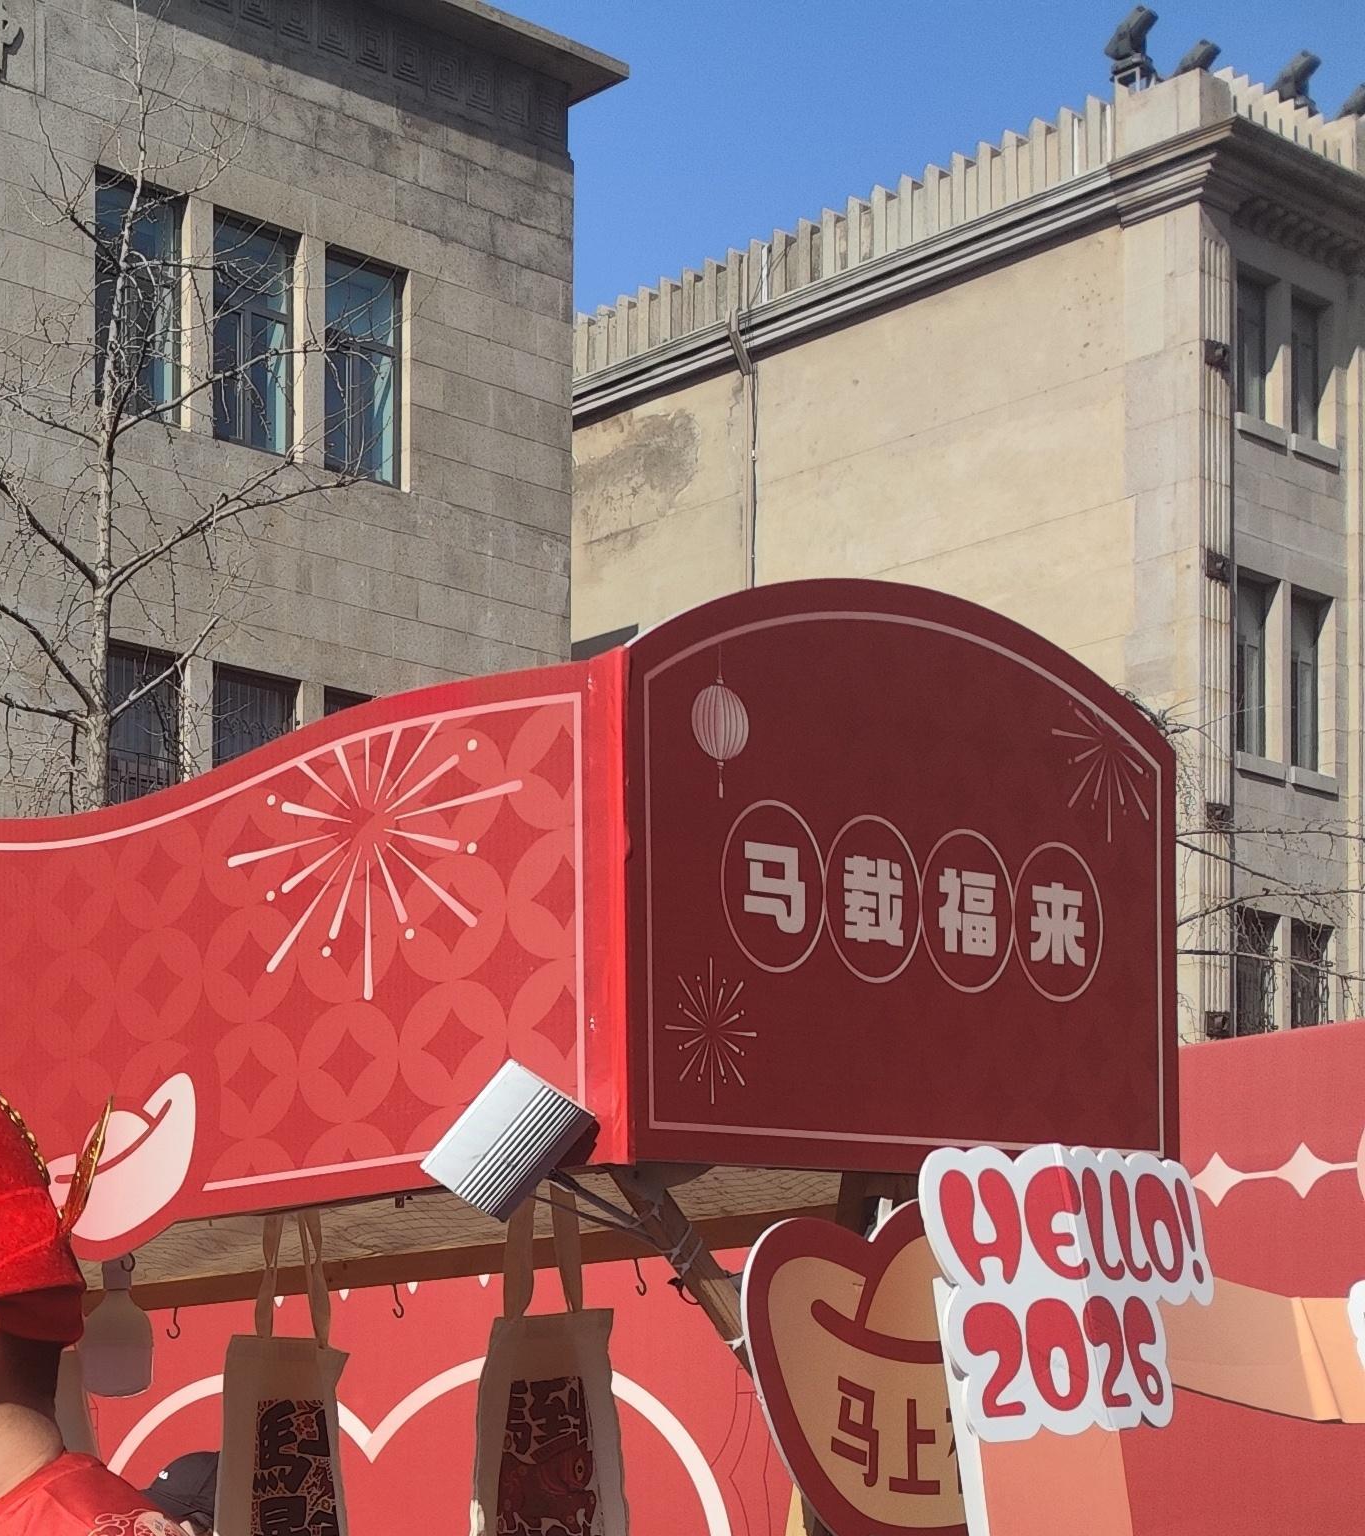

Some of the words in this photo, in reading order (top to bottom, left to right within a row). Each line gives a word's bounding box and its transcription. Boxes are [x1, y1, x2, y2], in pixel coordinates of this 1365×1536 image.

[743, 840, 1087, 969] 马载福来
[938, 1164, 1206, 1287] HELLO!
[962, 1294, 1166, 1418] 2026
[831, 1375, 963, 1496] 马上
